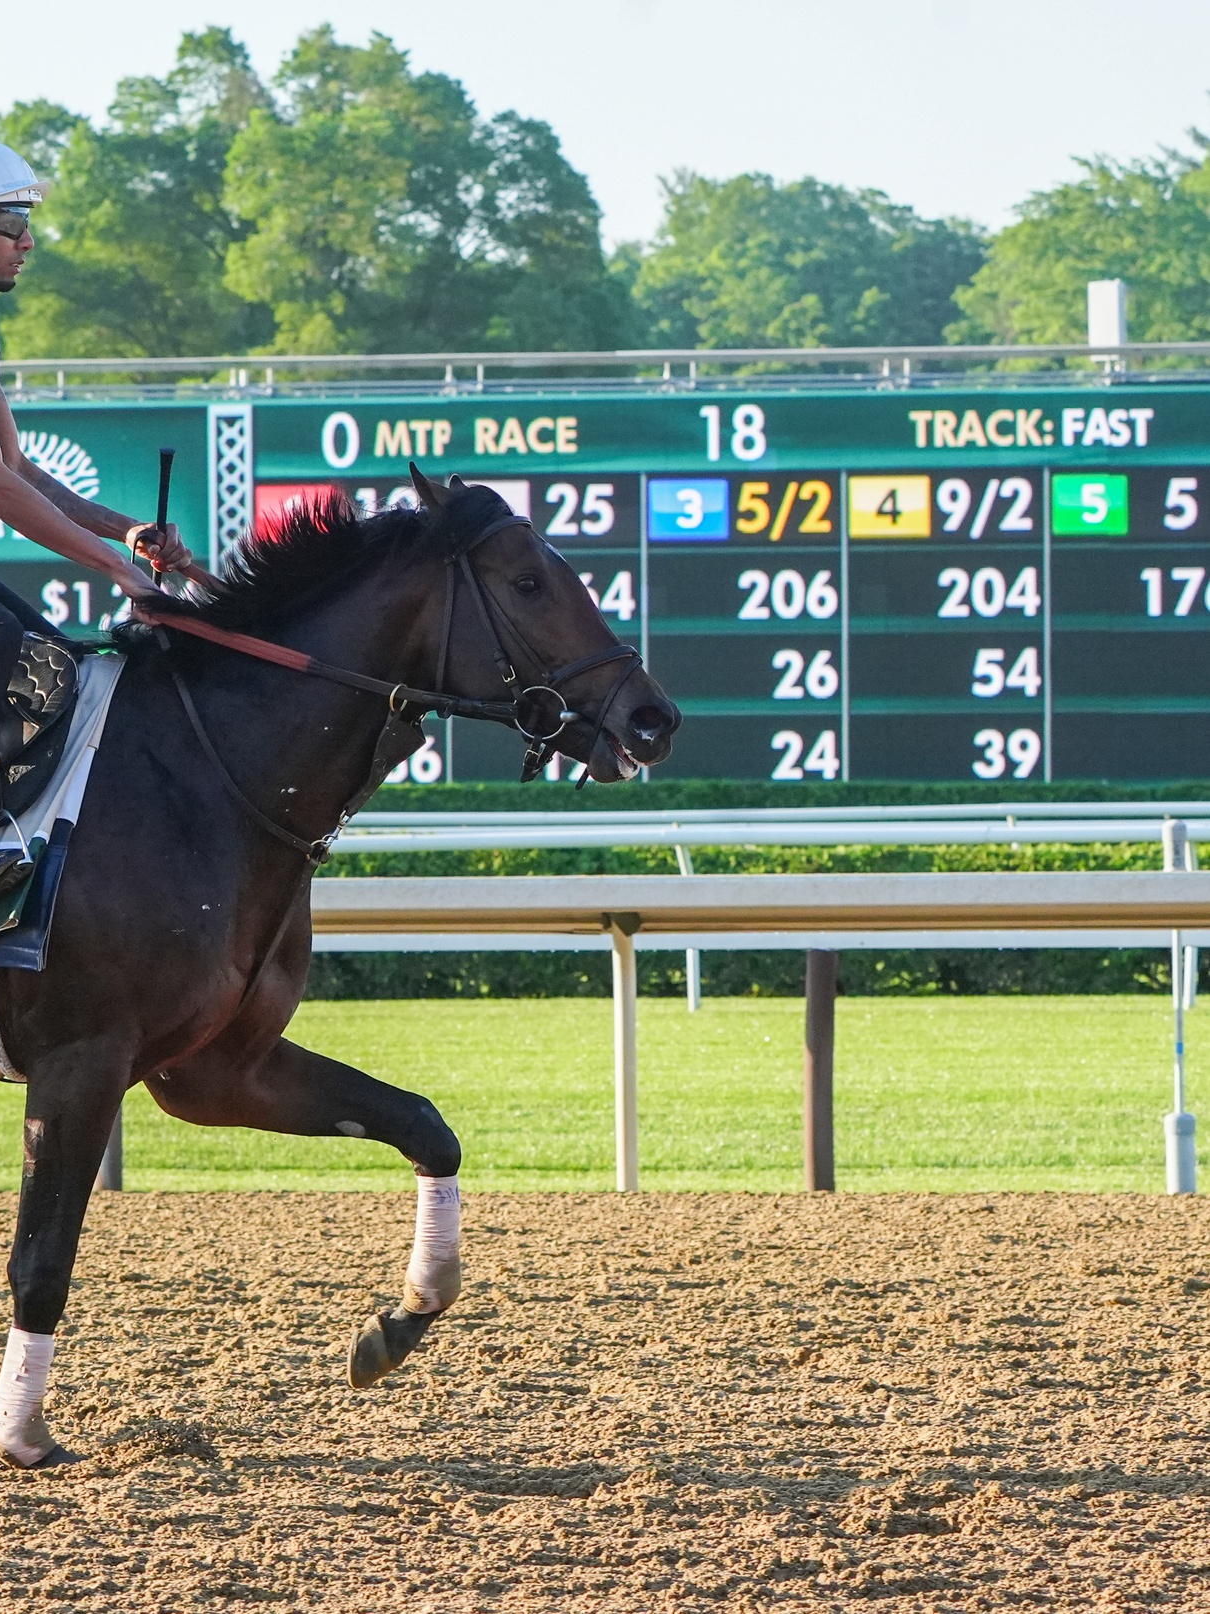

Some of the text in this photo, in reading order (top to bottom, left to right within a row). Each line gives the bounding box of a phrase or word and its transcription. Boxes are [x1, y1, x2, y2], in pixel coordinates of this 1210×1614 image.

[322, 411, 452, 469] 0 MTP
[475, 404, 767, 462] RACE 18
[909, 407, 1156, 448] TRACK: FAST
[546, 482, 615, 536] 25
[676, 479, 833, 542] 3 5/2
[875, 477, 1034, 539] 4 9/2
[1081, 477, 1199, 531] 5 5
[738, 569, 838, 620] 206
[938, 566, 1041, 617] 204
[1141, 566, 1210, 617] 17
[773, 649, 839, 699] 26
[972, 647, 1041, 697] 54
[772, 730, 840, 780] 24
[973, 728, 1041, 779] 39
